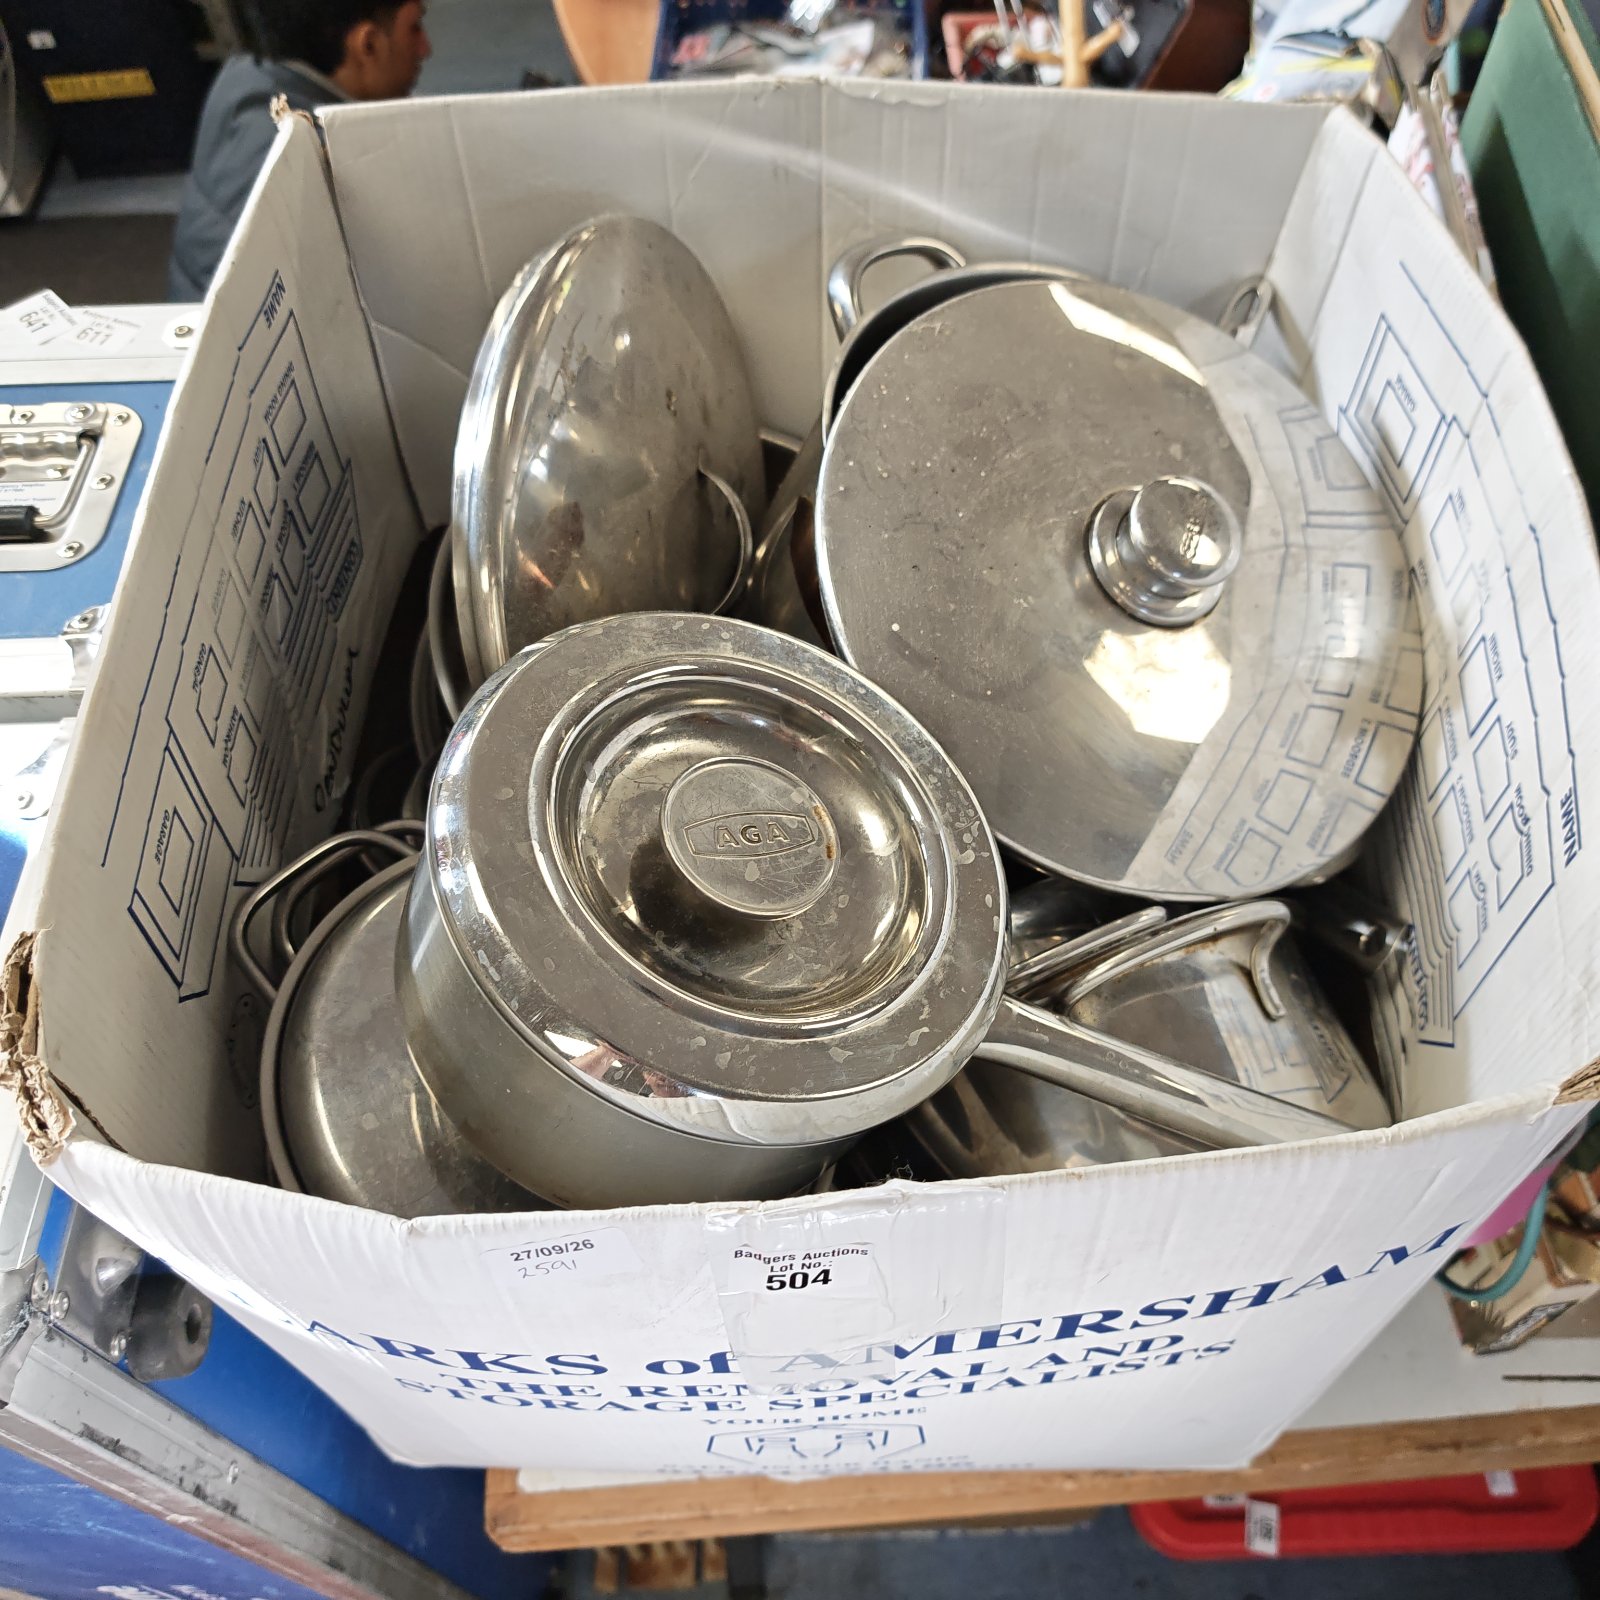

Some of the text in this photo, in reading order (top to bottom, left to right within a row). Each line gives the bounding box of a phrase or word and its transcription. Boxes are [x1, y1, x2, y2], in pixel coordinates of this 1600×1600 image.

[263, 275, 286, 329] NAME
[1505, 721, 1518, 761] STUDY
[1514, 782, 1532, 827] ROOM
[155, 809, 170, 865] GARAGE
[717, 821, 790, 849] AGA
[1560, 787, 1577, 868] NAME
[510, 1239, 594, 1261] 27/09/26
[518, 1259, 577, 1279] 2591
[734, 1247, 868, 1264] Badgers Auctions
[770, 1263, 794, 1273] Lot
[646, 1350, 737, 1375] of
[770, 1219, 1470, 1372] AMERSHAM
[766, 1268, 832, 1291] 504
[395, 1339, 1236, 1412] STORAGE SPECIALISTS
[439, 1373, 602, 1397] THE
[1023, 1334, 1184, 1368] AND
